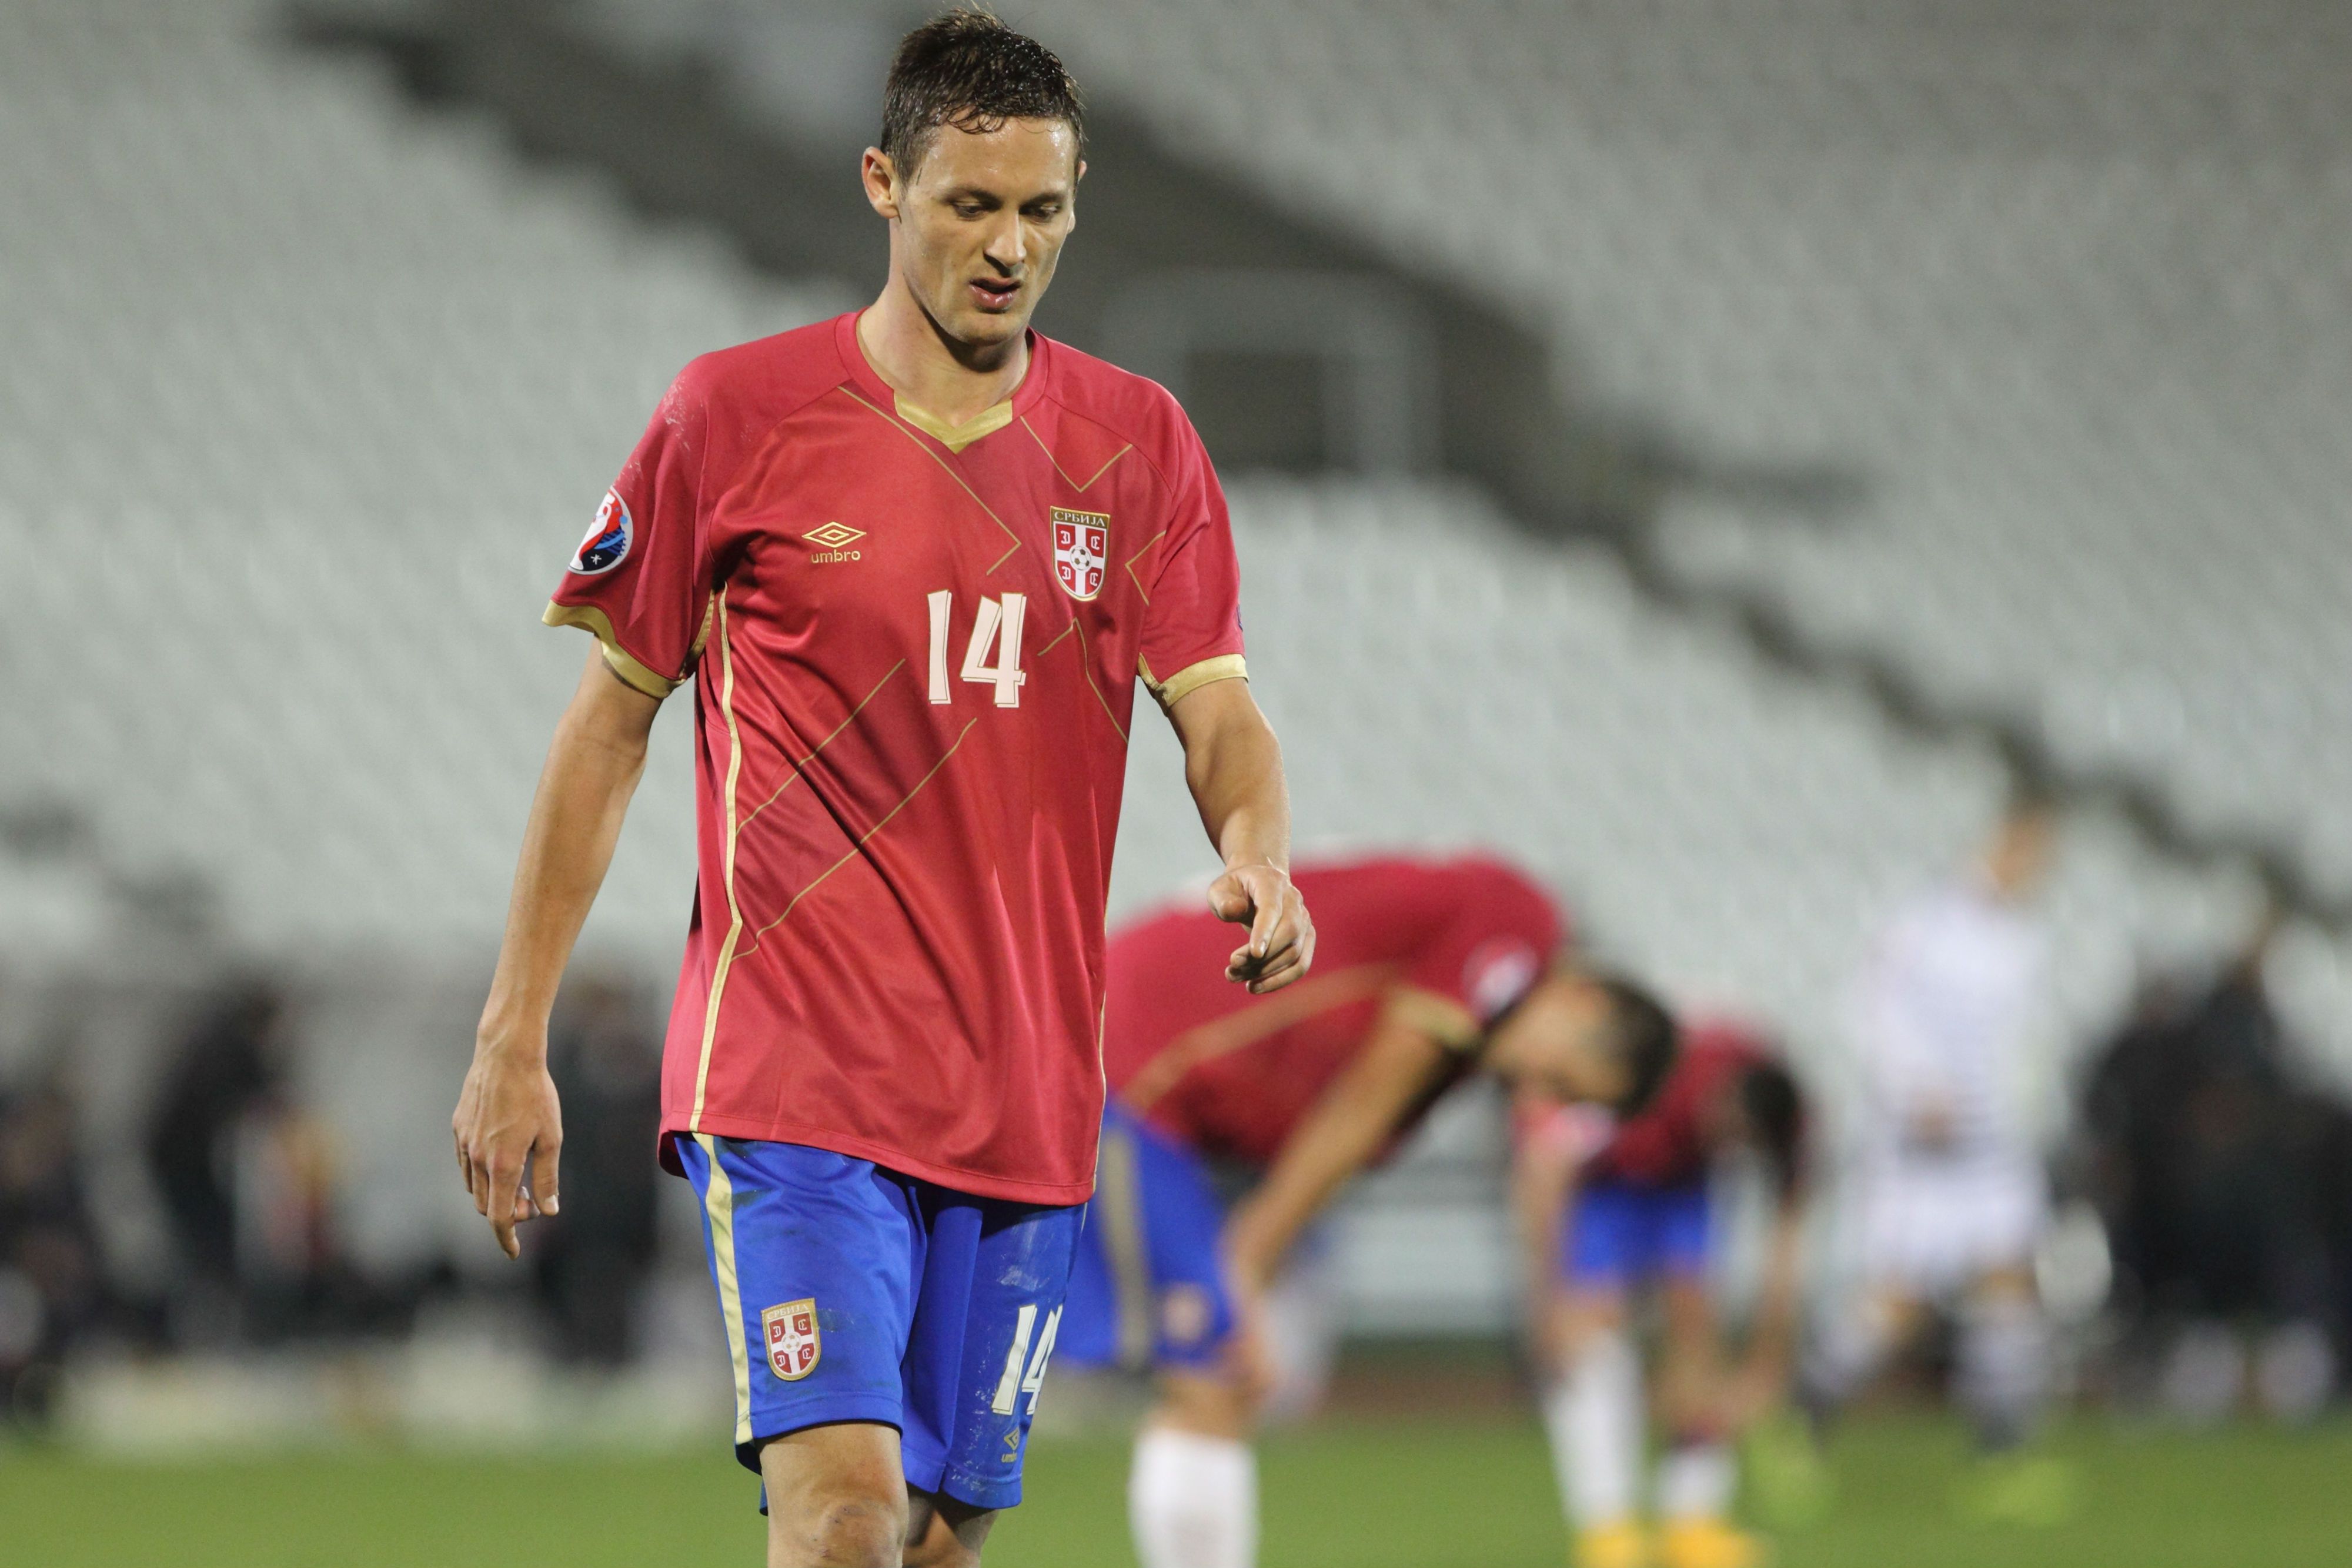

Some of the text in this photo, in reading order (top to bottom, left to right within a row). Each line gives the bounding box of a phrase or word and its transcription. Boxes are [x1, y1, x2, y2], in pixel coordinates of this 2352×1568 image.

[1054, 511, 1105, 527] СРБИЈА
[811, 549, 861, 563] umbro
[927, 589, 1027, 708] 14
[767, 1304, 808, 1319] СРБИЈА
[991, 1304, 1063, 1415] 14
